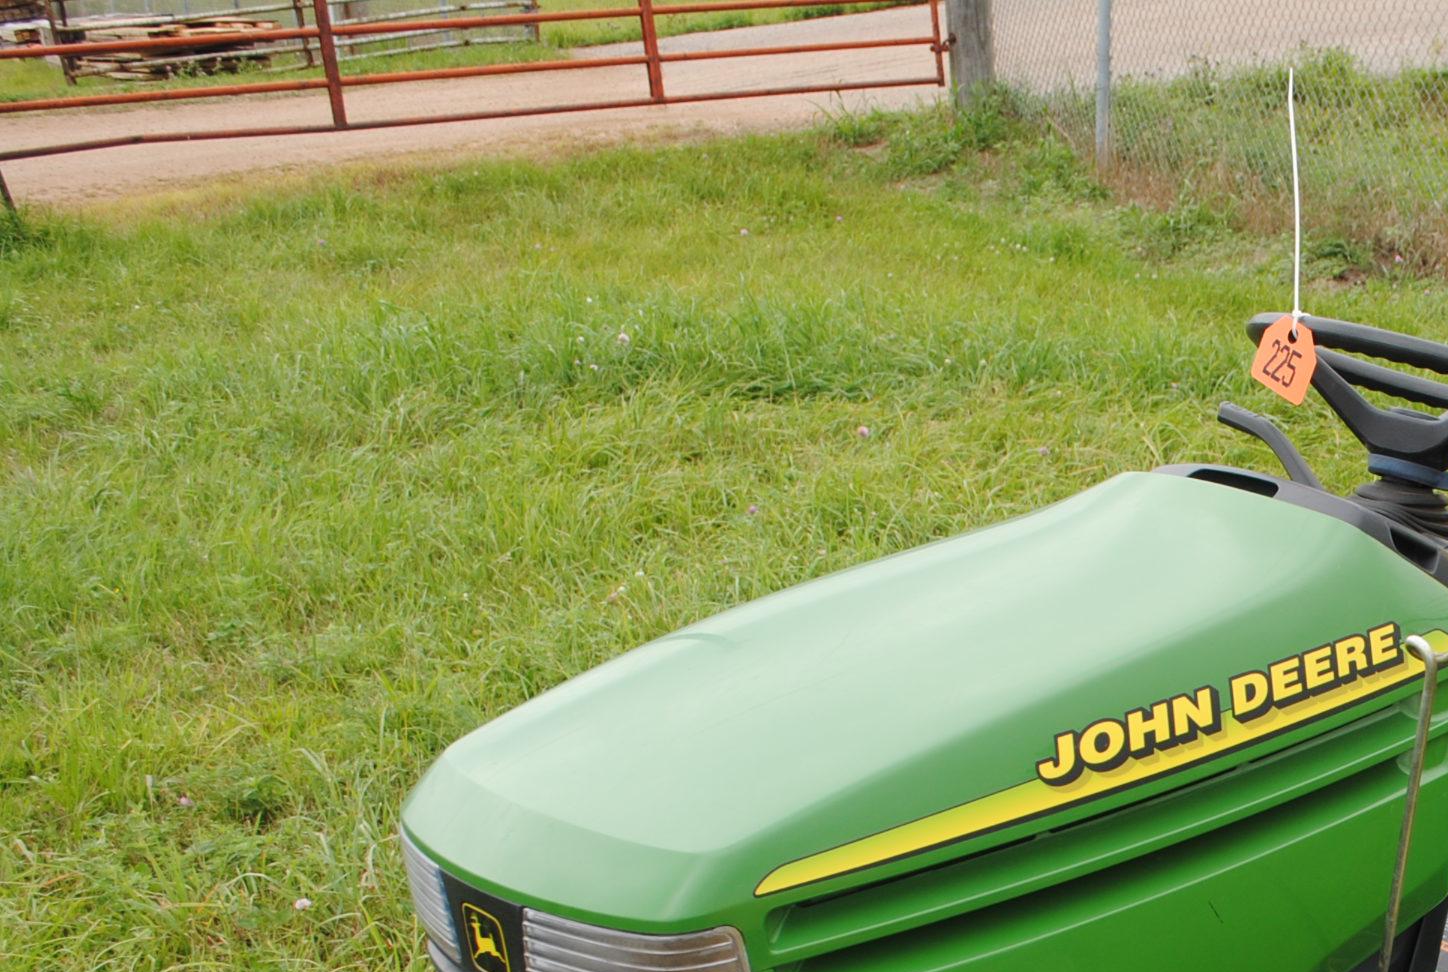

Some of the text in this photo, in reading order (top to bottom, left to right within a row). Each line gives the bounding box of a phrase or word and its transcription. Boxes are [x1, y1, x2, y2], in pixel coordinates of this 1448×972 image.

[1262, 339, 1303, 388] 225
[1037, 622, 1402, 785] JOHN DEERE
